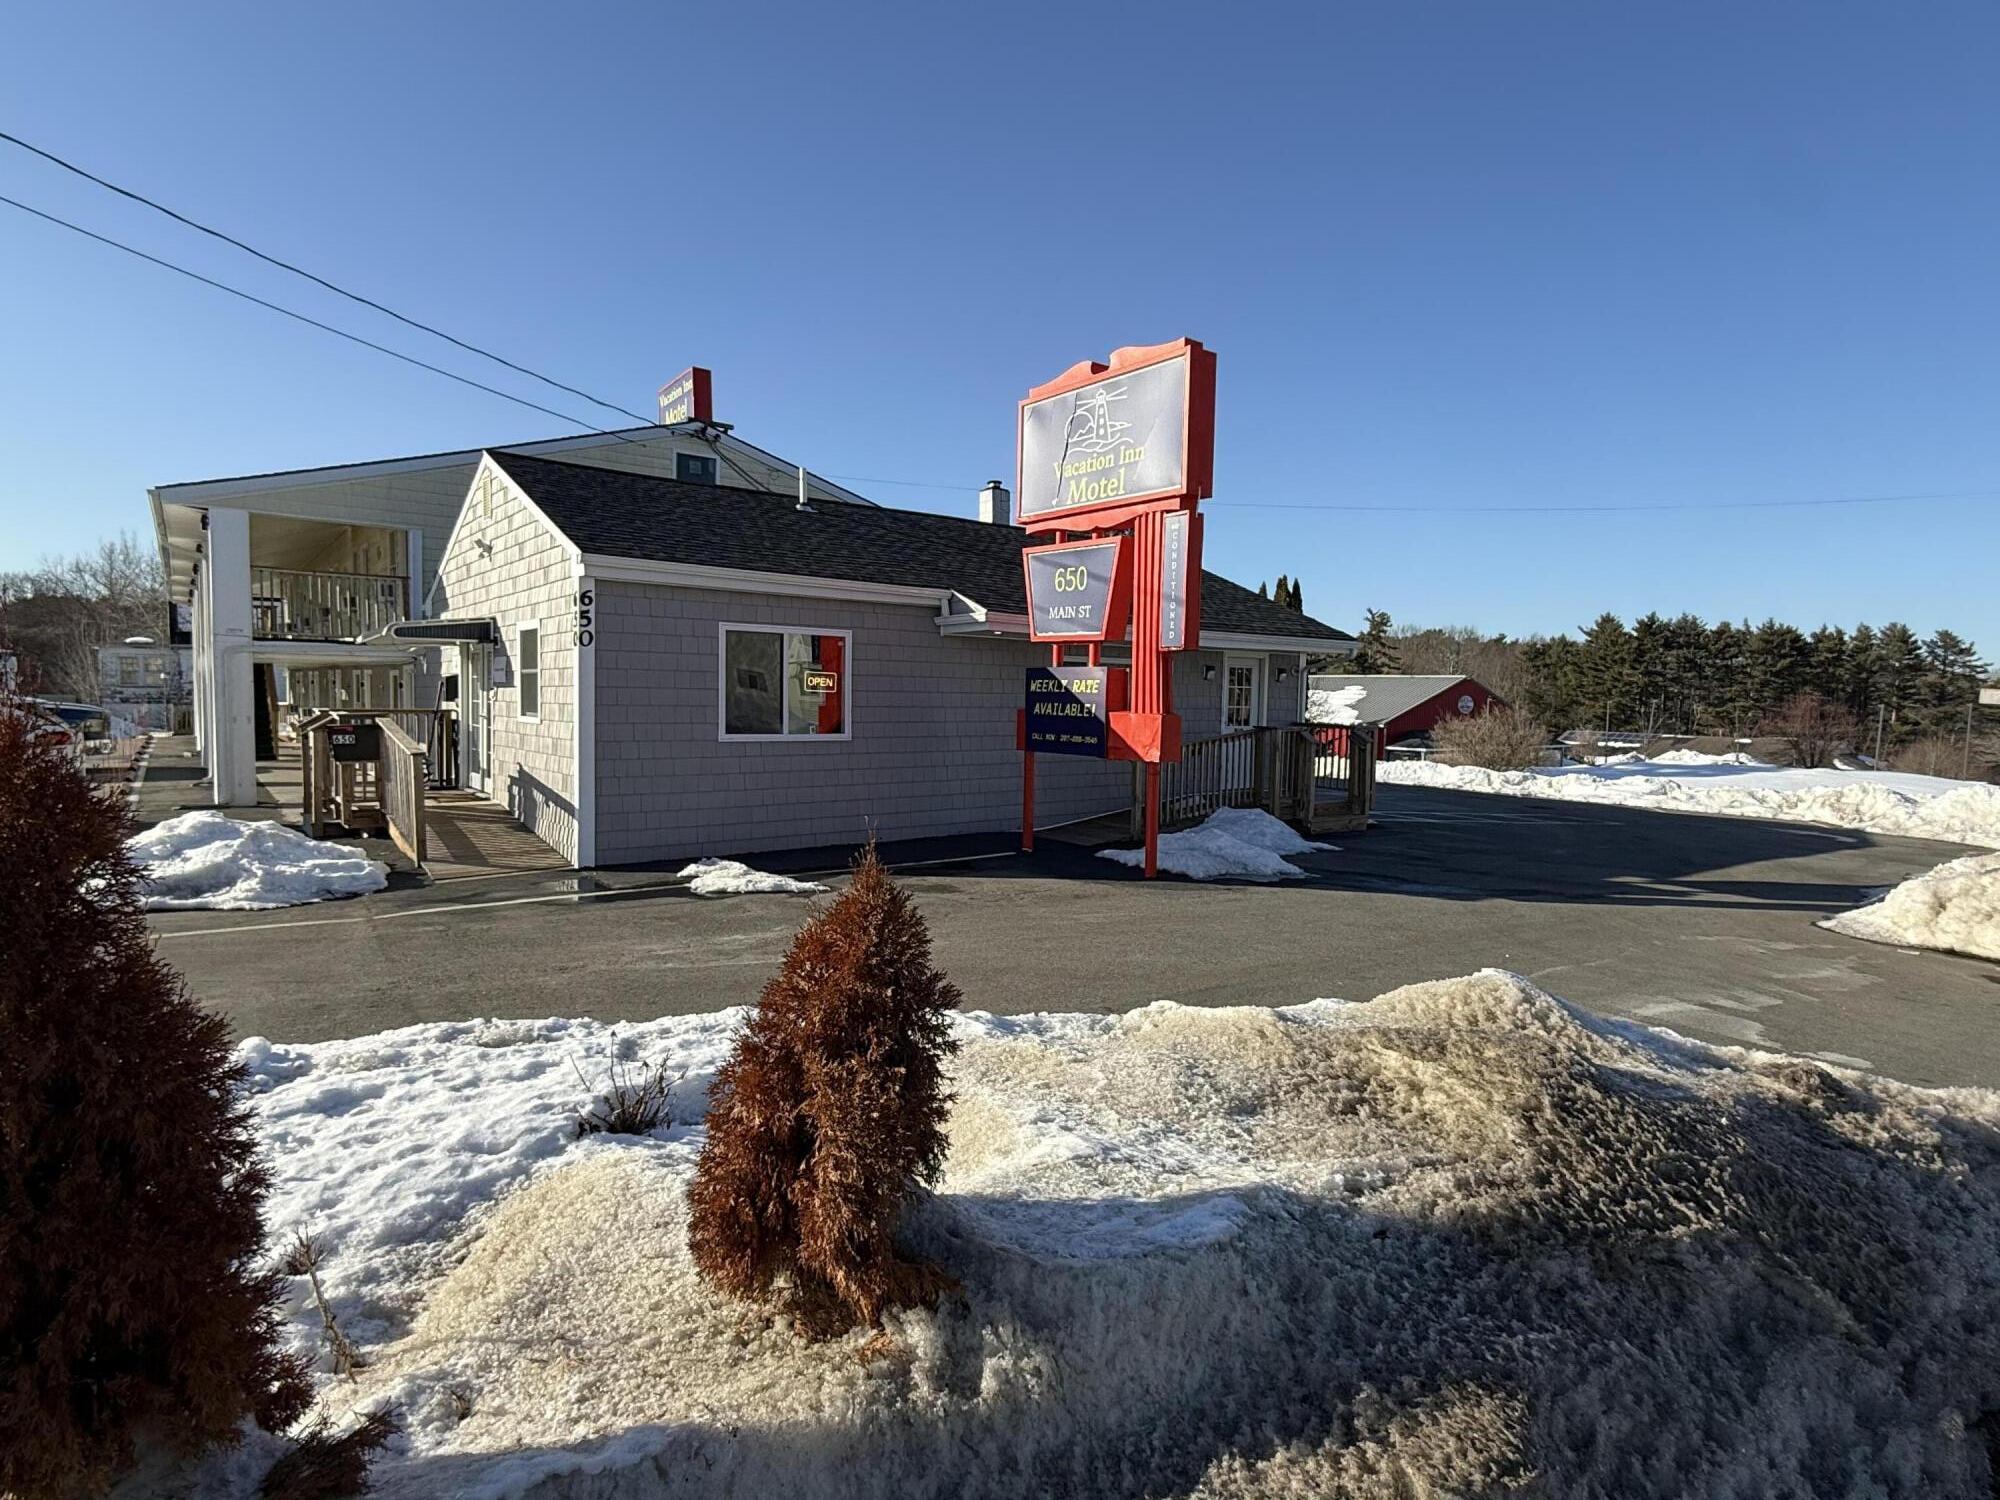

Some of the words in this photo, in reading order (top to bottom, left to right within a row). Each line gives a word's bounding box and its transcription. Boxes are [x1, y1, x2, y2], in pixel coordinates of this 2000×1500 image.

[665, 396, 688, 424] Motel
[1053, 453, 1115, 480] Vacation
[1119, 446, 1145, 465] Inn
[1066, 467, 1125, 505] Motel
[1054, 565, 1087, 592] 650
[579, 589, 594, 648] 650
[1048, 605, 1077, 619] MAIN
[1078, 605, 1092, 618] ST
[808, 677, 833, 687] OPEN
[1030, 679, 1069, 693] WEEKLY
[1072, 679, 1101, 694] RATE
[1033, 702, 1097, 717] AVAILABLE!
[334, 735, 355, 743] 650
